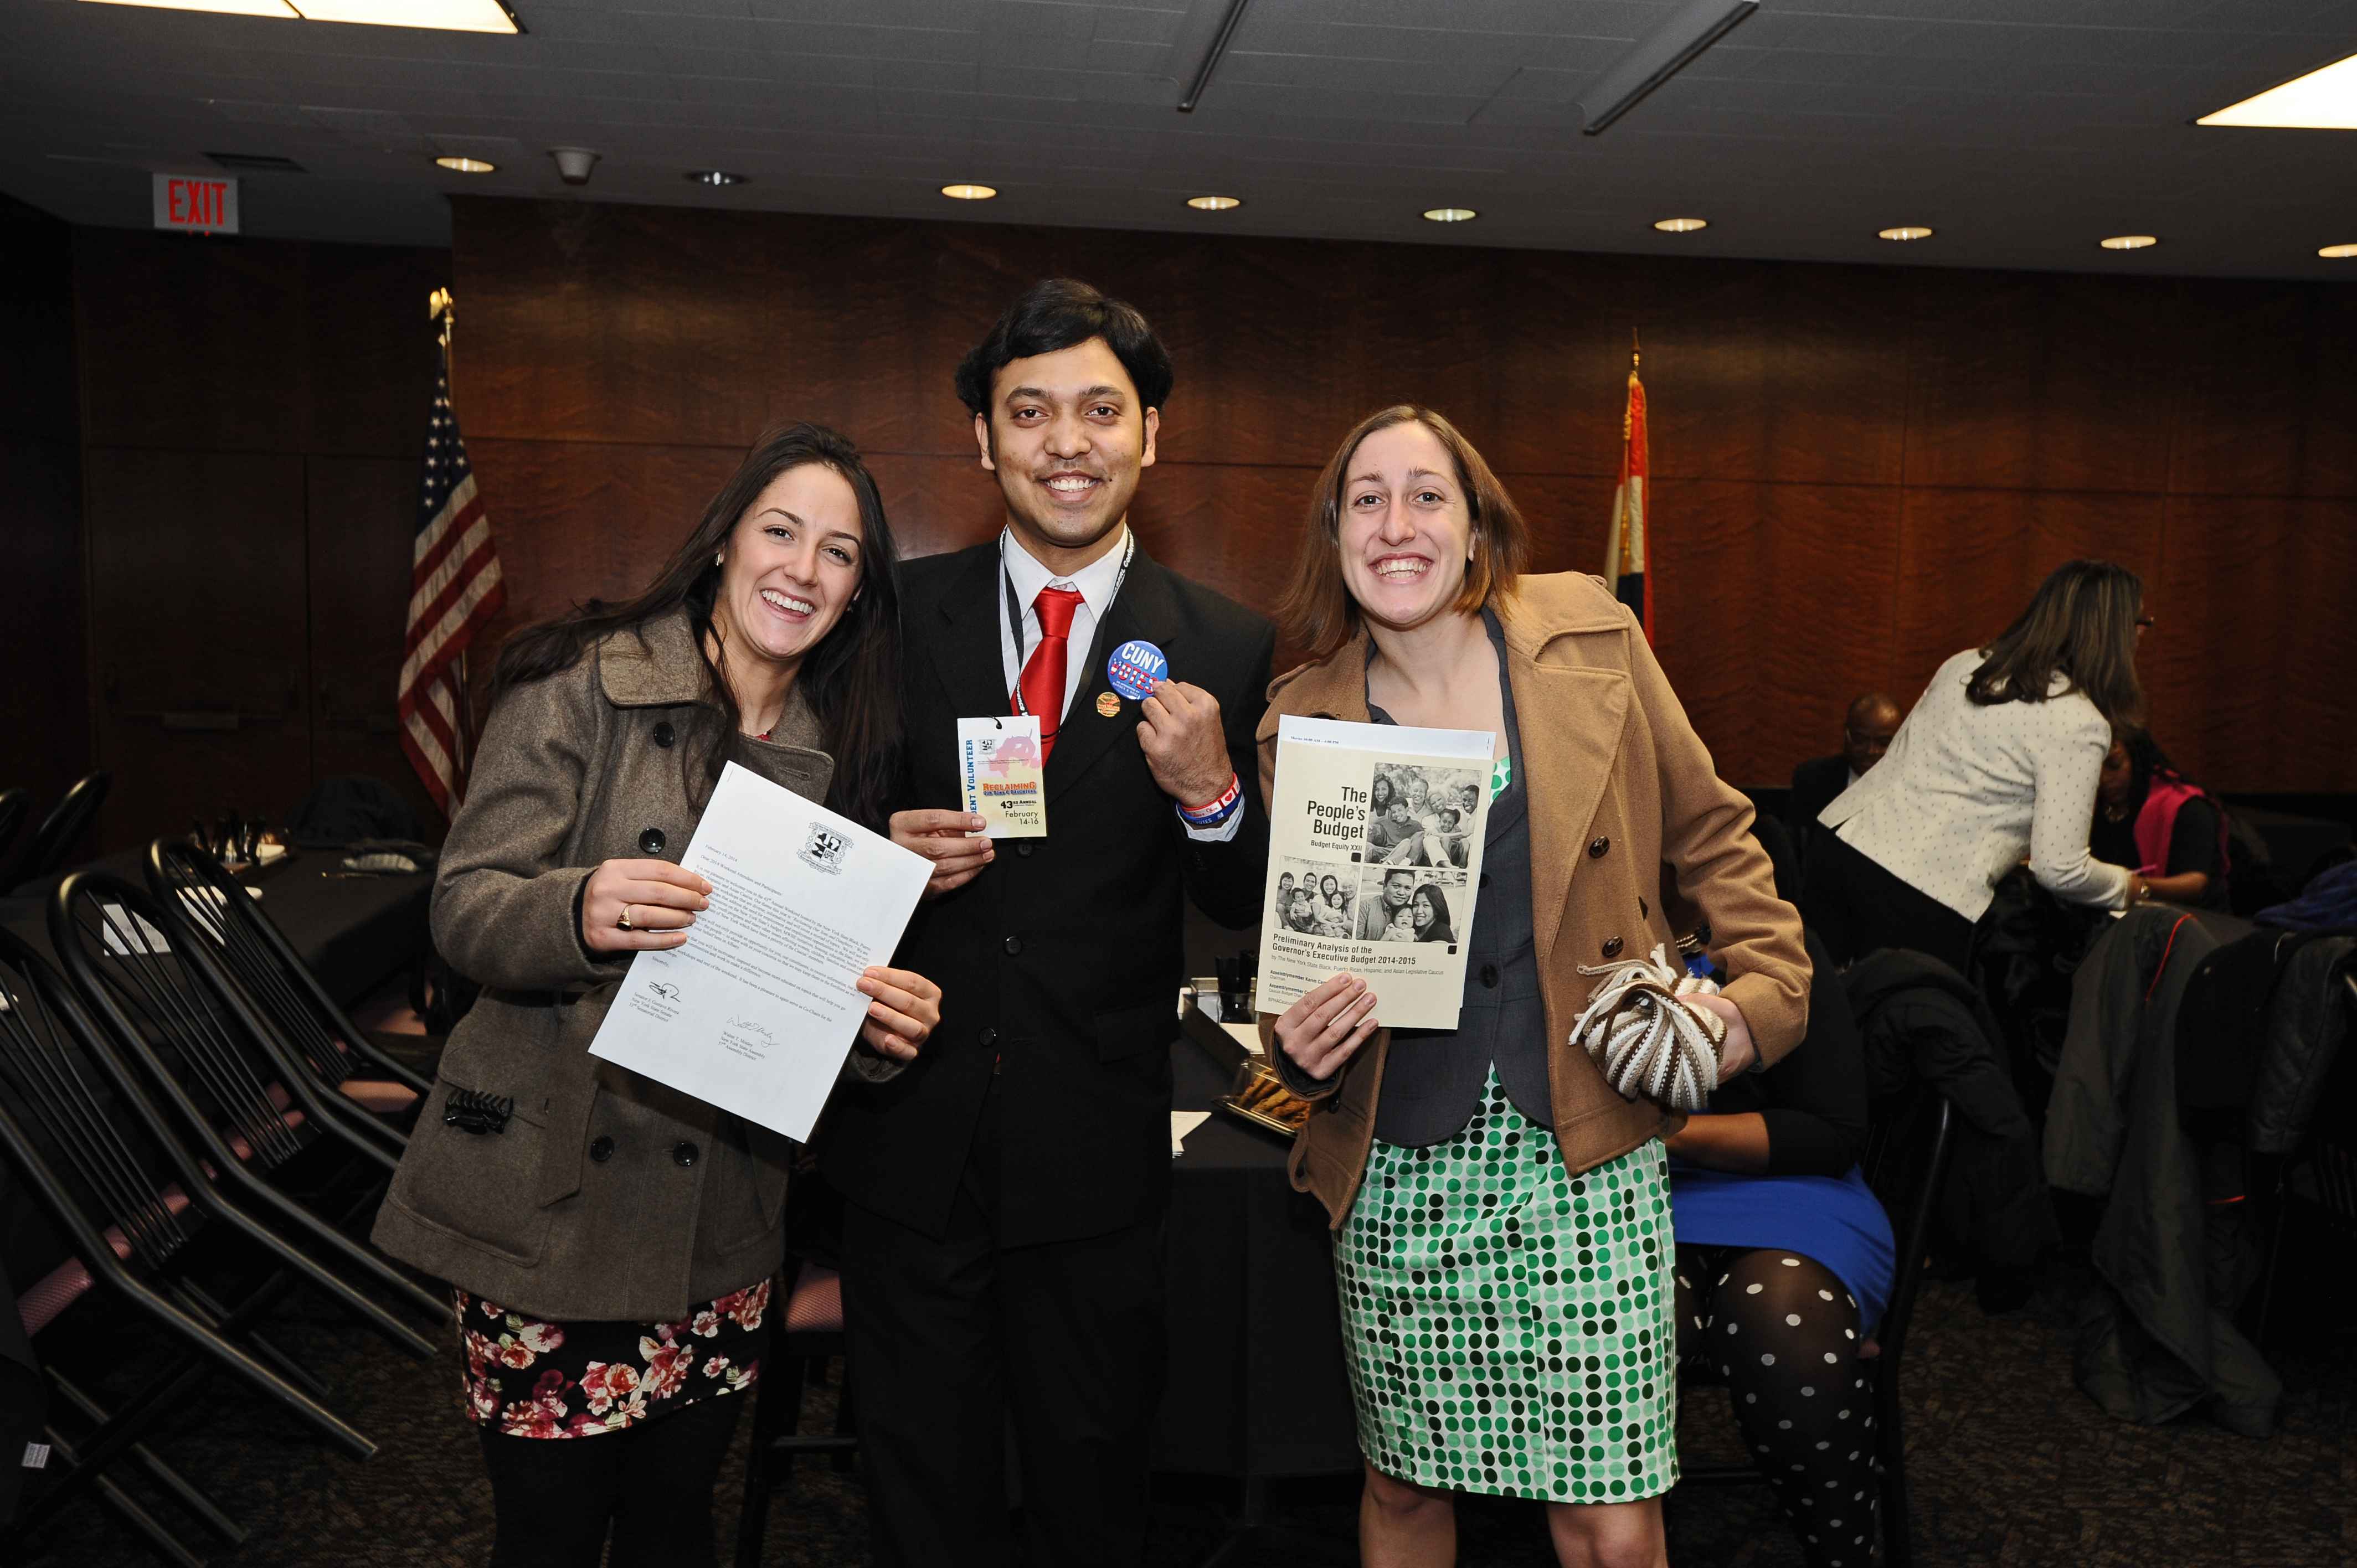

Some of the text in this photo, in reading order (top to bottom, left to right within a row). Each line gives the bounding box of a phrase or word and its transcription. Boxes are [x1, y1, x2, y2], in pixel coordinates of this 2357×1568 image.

[168, 179, 227, 226] EXIT
[1121, 643, 1165, 674] CUNY
[1110, 658, 1159, 694] VOTES
[1341, 786, 1367, 803] The
[1307, 800, 1366, 822] People's
[1313, 819, 1364, 840] Budget
[705, 844, 722, 855] February
[1311, 840, 1330, 848] Budget
[1332, 843, 1349, 851] Equity
[1273, 933, 1315, 950] Preliminary
[1317, 942, 1349, 953] Analysis
[1273, 943, 1416, 964] Governor's Executive Budget 2014-2015
[1270, 969, 1305, 980] Assemblymember
[1269, 983, 1304, 993] Assemblymember
[659, 1009, 672, 1018] Senate
[748, 1048, 765, 1059] Assembly
